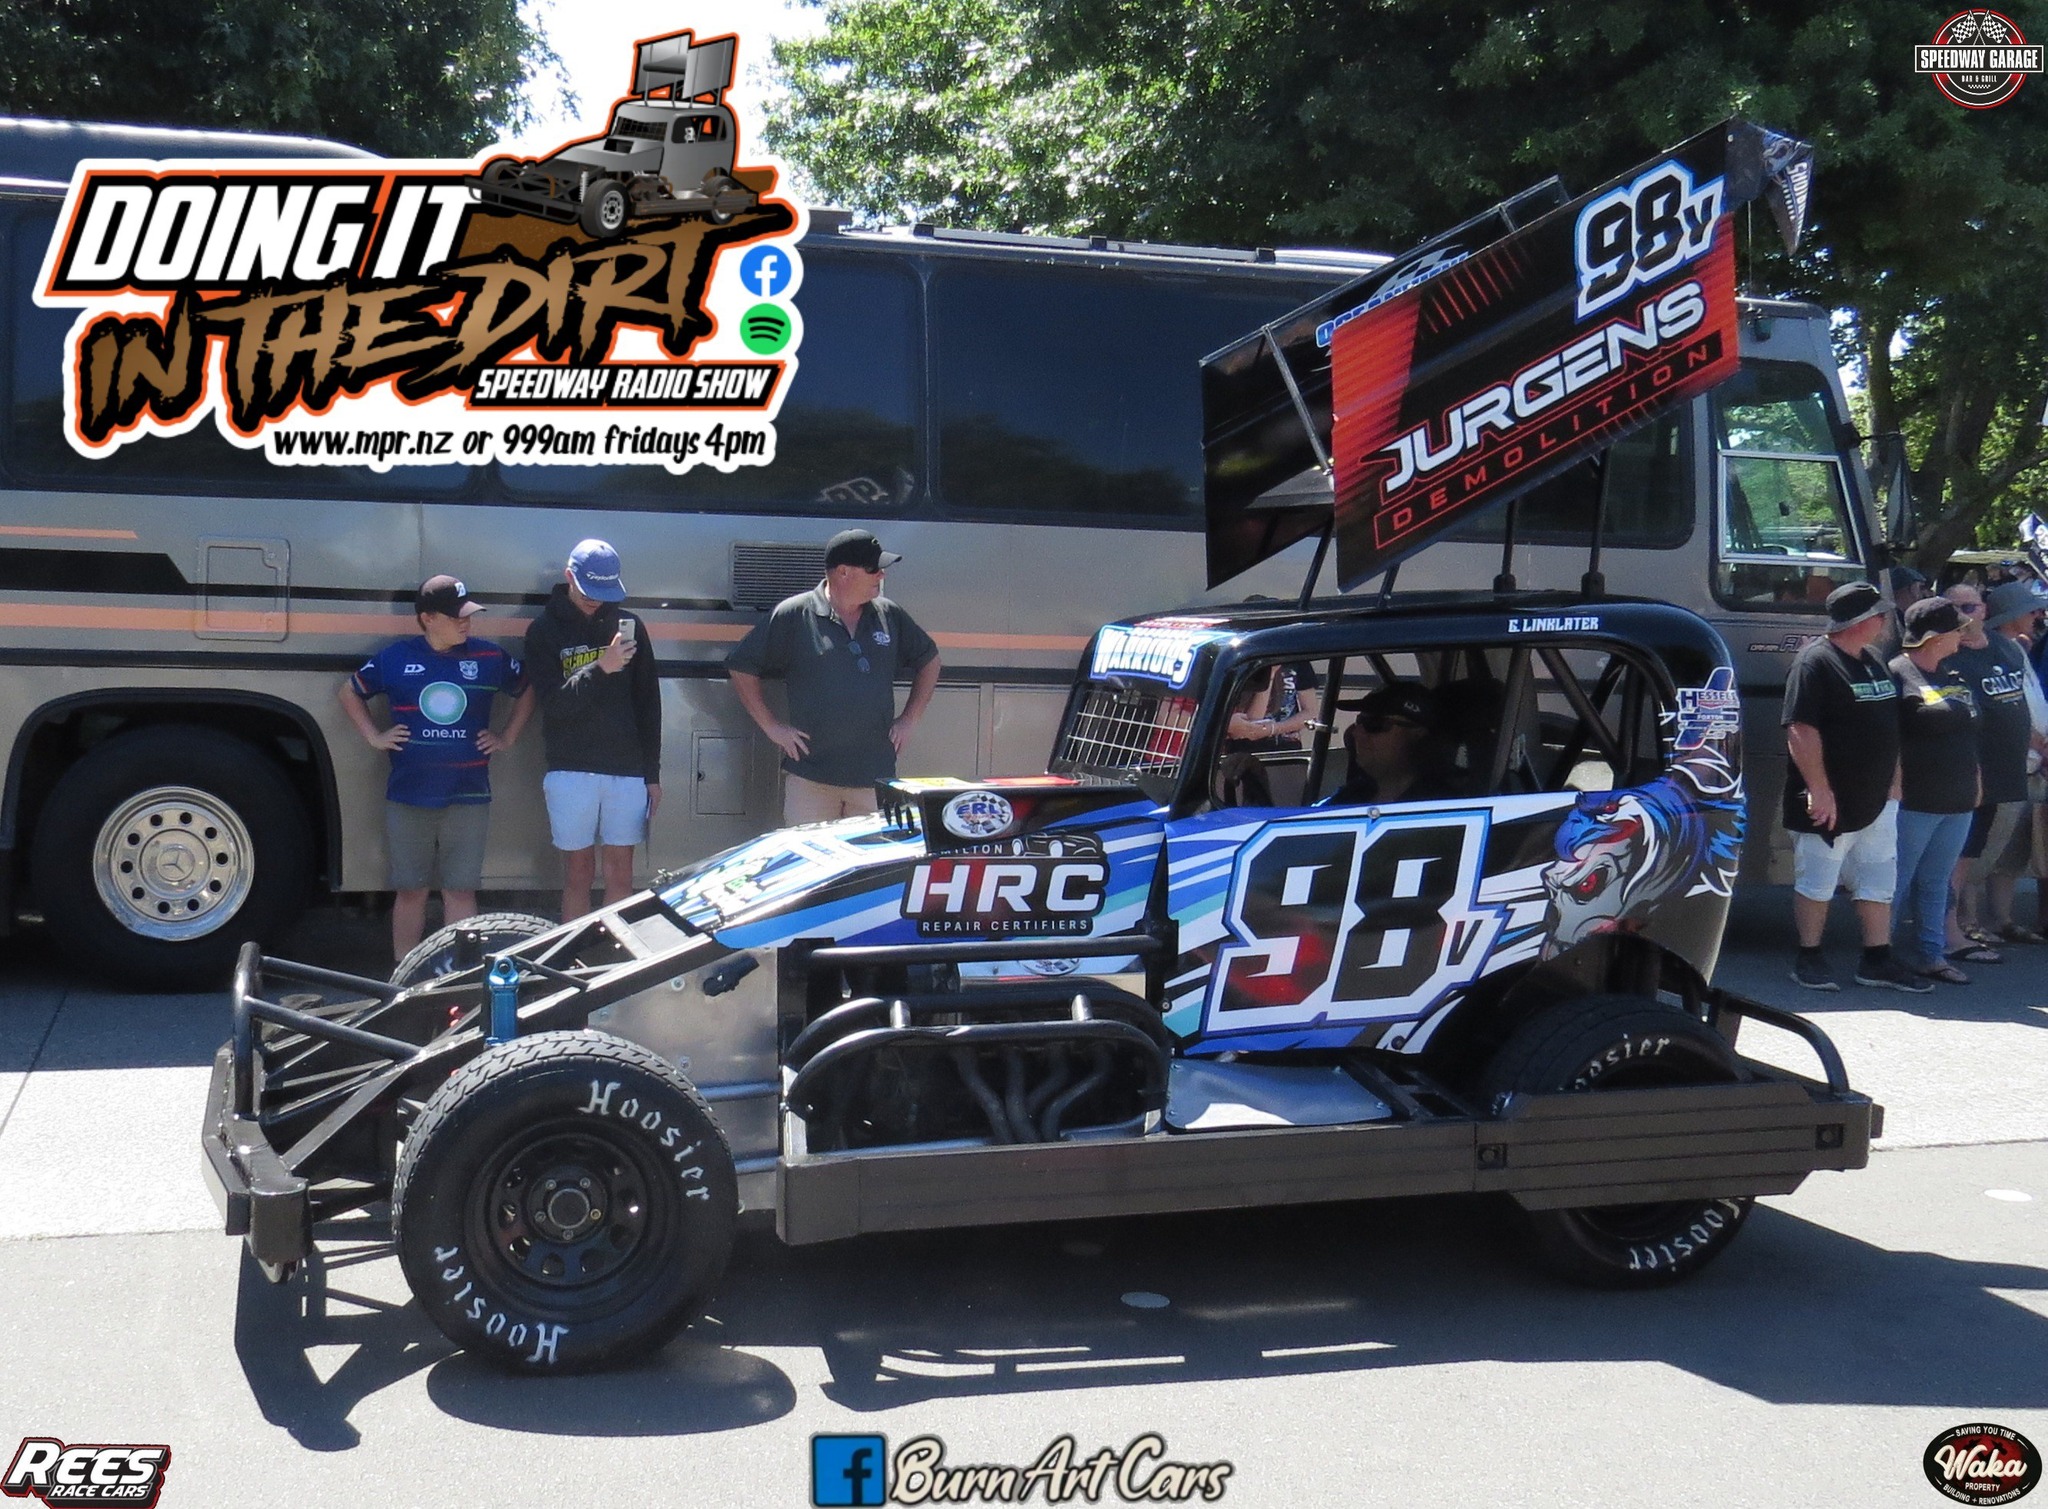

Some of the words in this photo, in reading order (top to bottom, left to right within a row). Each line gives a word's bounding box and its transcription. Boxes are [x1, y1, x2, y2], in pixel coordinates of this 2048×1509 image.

[1380, 281, 1706, 493] JURGENS
[1391, 348, 1708, 531] DEMOLITION
[1522, 616, 1599, 632] LINKLATER
[422, 727, 467, 739] one.nz
[956, 802, 1001, 815] ERL
[949, 844, 1004, 855] ILTON
[906, 864, 1104, 913] HRC
[922, 921, 982, 932] REPAIR
[990, 919, 1088, 931] CERTIFIERS
[1560, 1033, 1671, 1090] oosier
[578, 1079, 710, 1200] Hoosier
[434, 1246, 569, 1364] Hoosier
